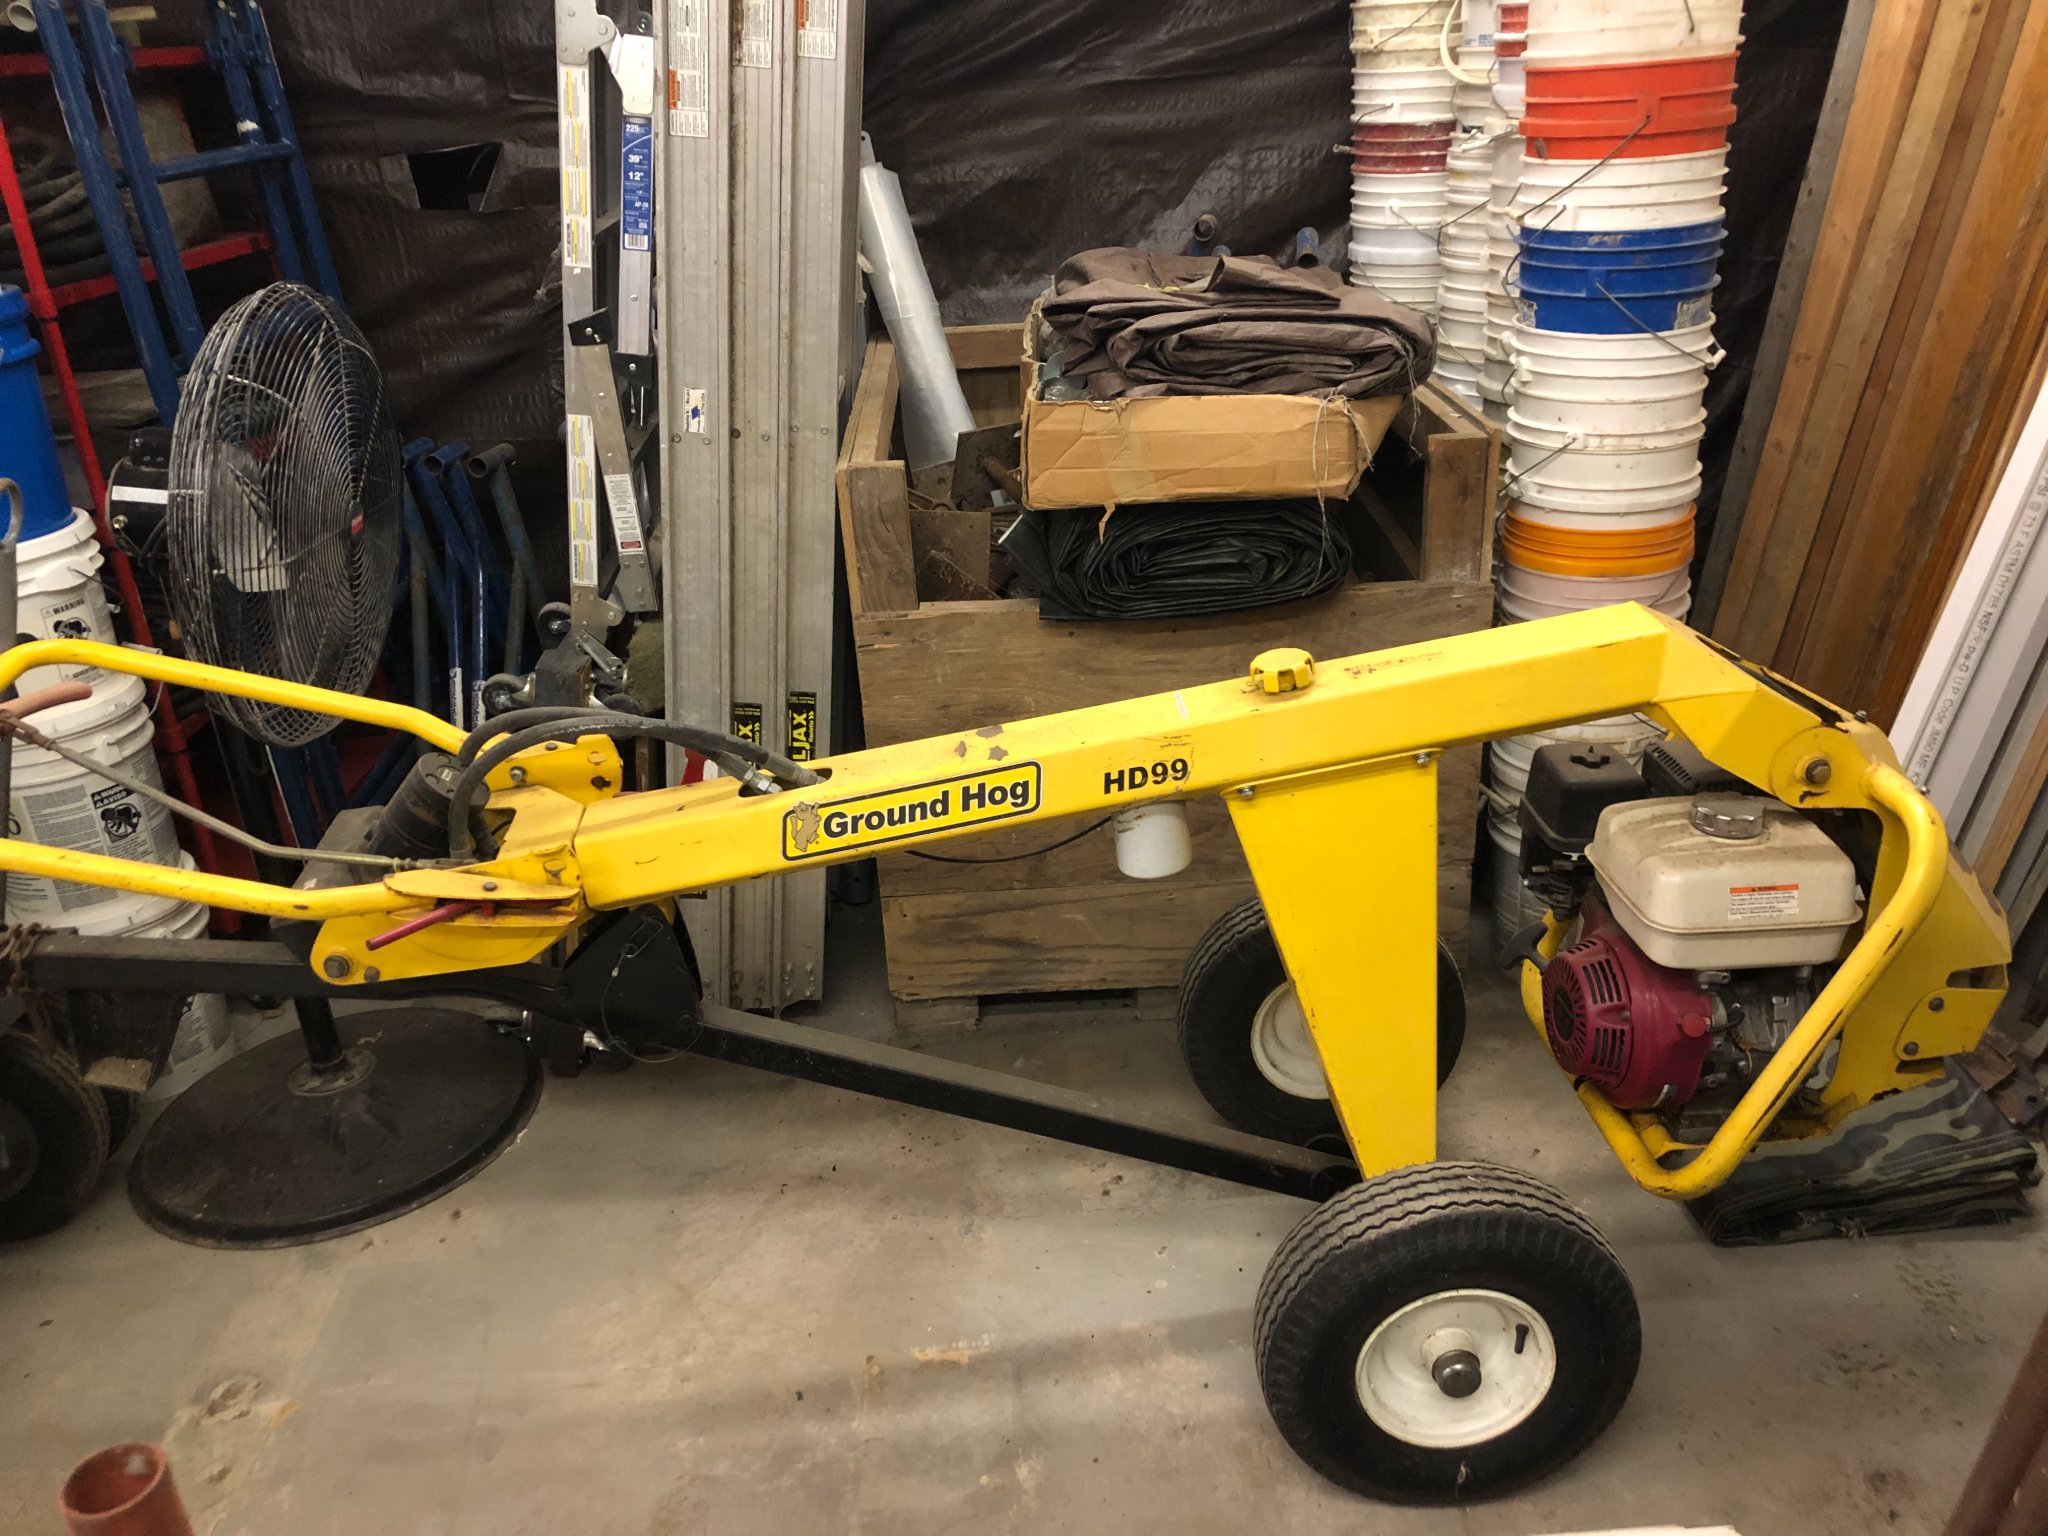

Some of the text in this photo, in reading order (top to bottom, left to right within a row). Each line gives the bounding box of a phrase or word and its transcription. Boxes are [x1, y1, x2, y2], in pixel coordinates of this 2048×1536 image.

[626, 124, 639, 133] 225
[628, 154, 643, 163] 39"
[628, 171, 644, 180] 12"
[2002, 539, 2024, 573] ASTM
[52, 597, 86, 615] WARNING
[792, 712, 811, 760] LJAX
[1104, 758, 1189, 795] HD99
[823, 779, 1030, 839] Ground Hog
